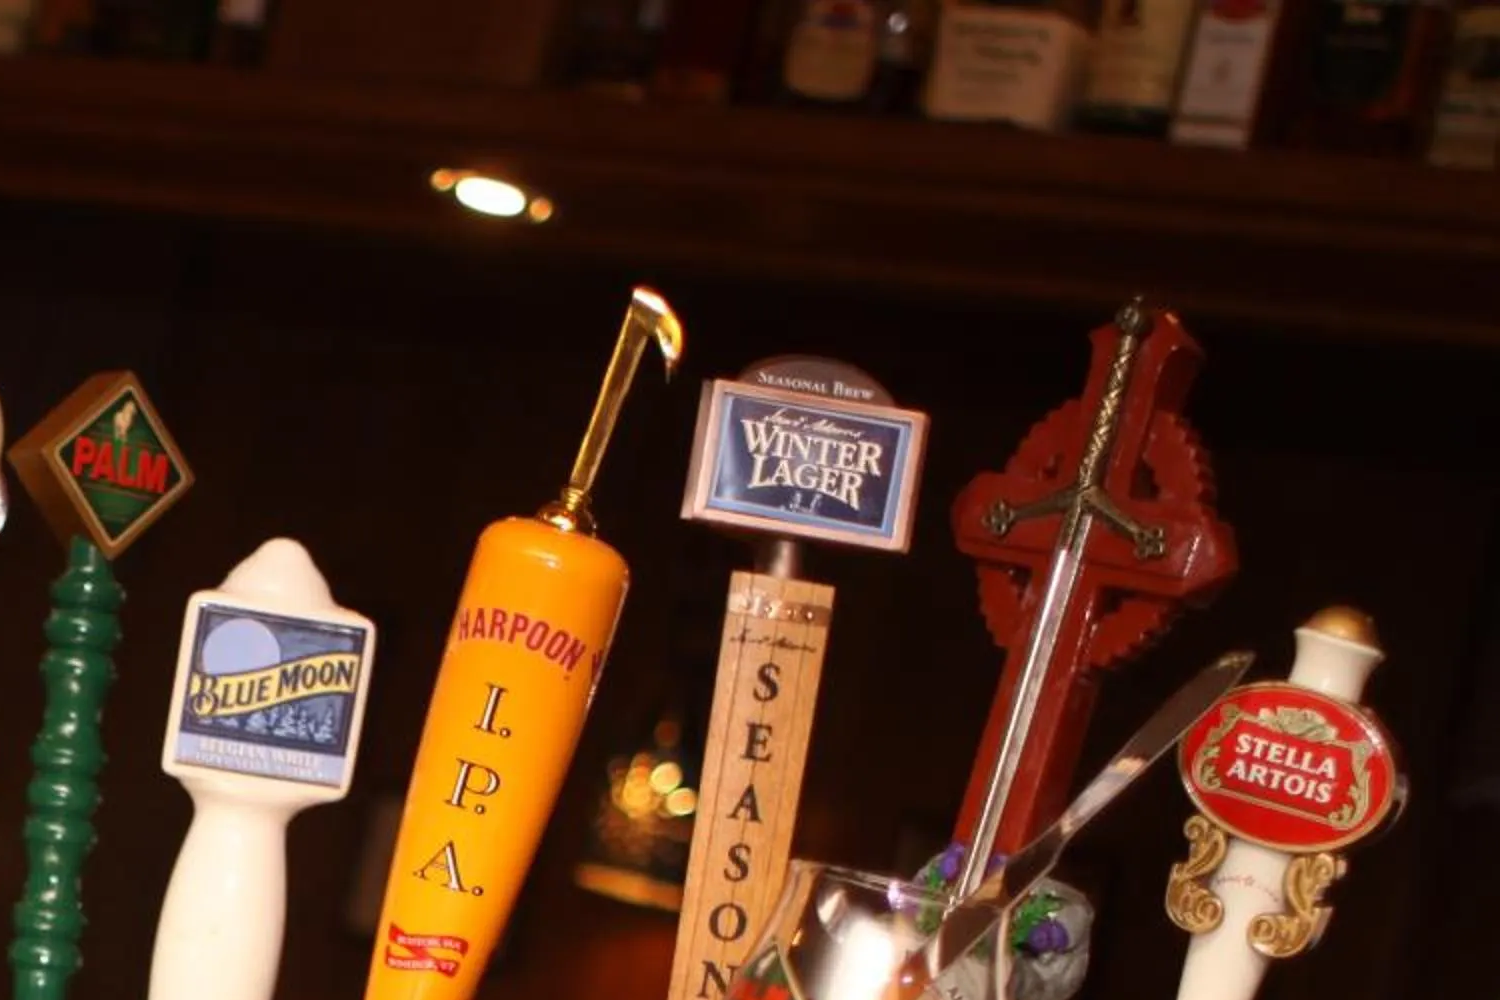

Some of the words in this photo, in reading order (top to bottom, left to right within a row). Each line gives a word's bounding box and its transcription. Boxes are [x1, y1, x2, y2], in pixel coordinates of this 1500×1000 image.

[72, 435, 168, 493] PALM
[740, 419, 882, 477] WINTER
[747, 453, 861, 511] LAGER
[458, 607, 587, 673] HARPOON
[276, 660, 357, 698] MOON
[1226, 758, 1333, 804] ARTOIS
[1235, 733, 1336, 778] STELLA
